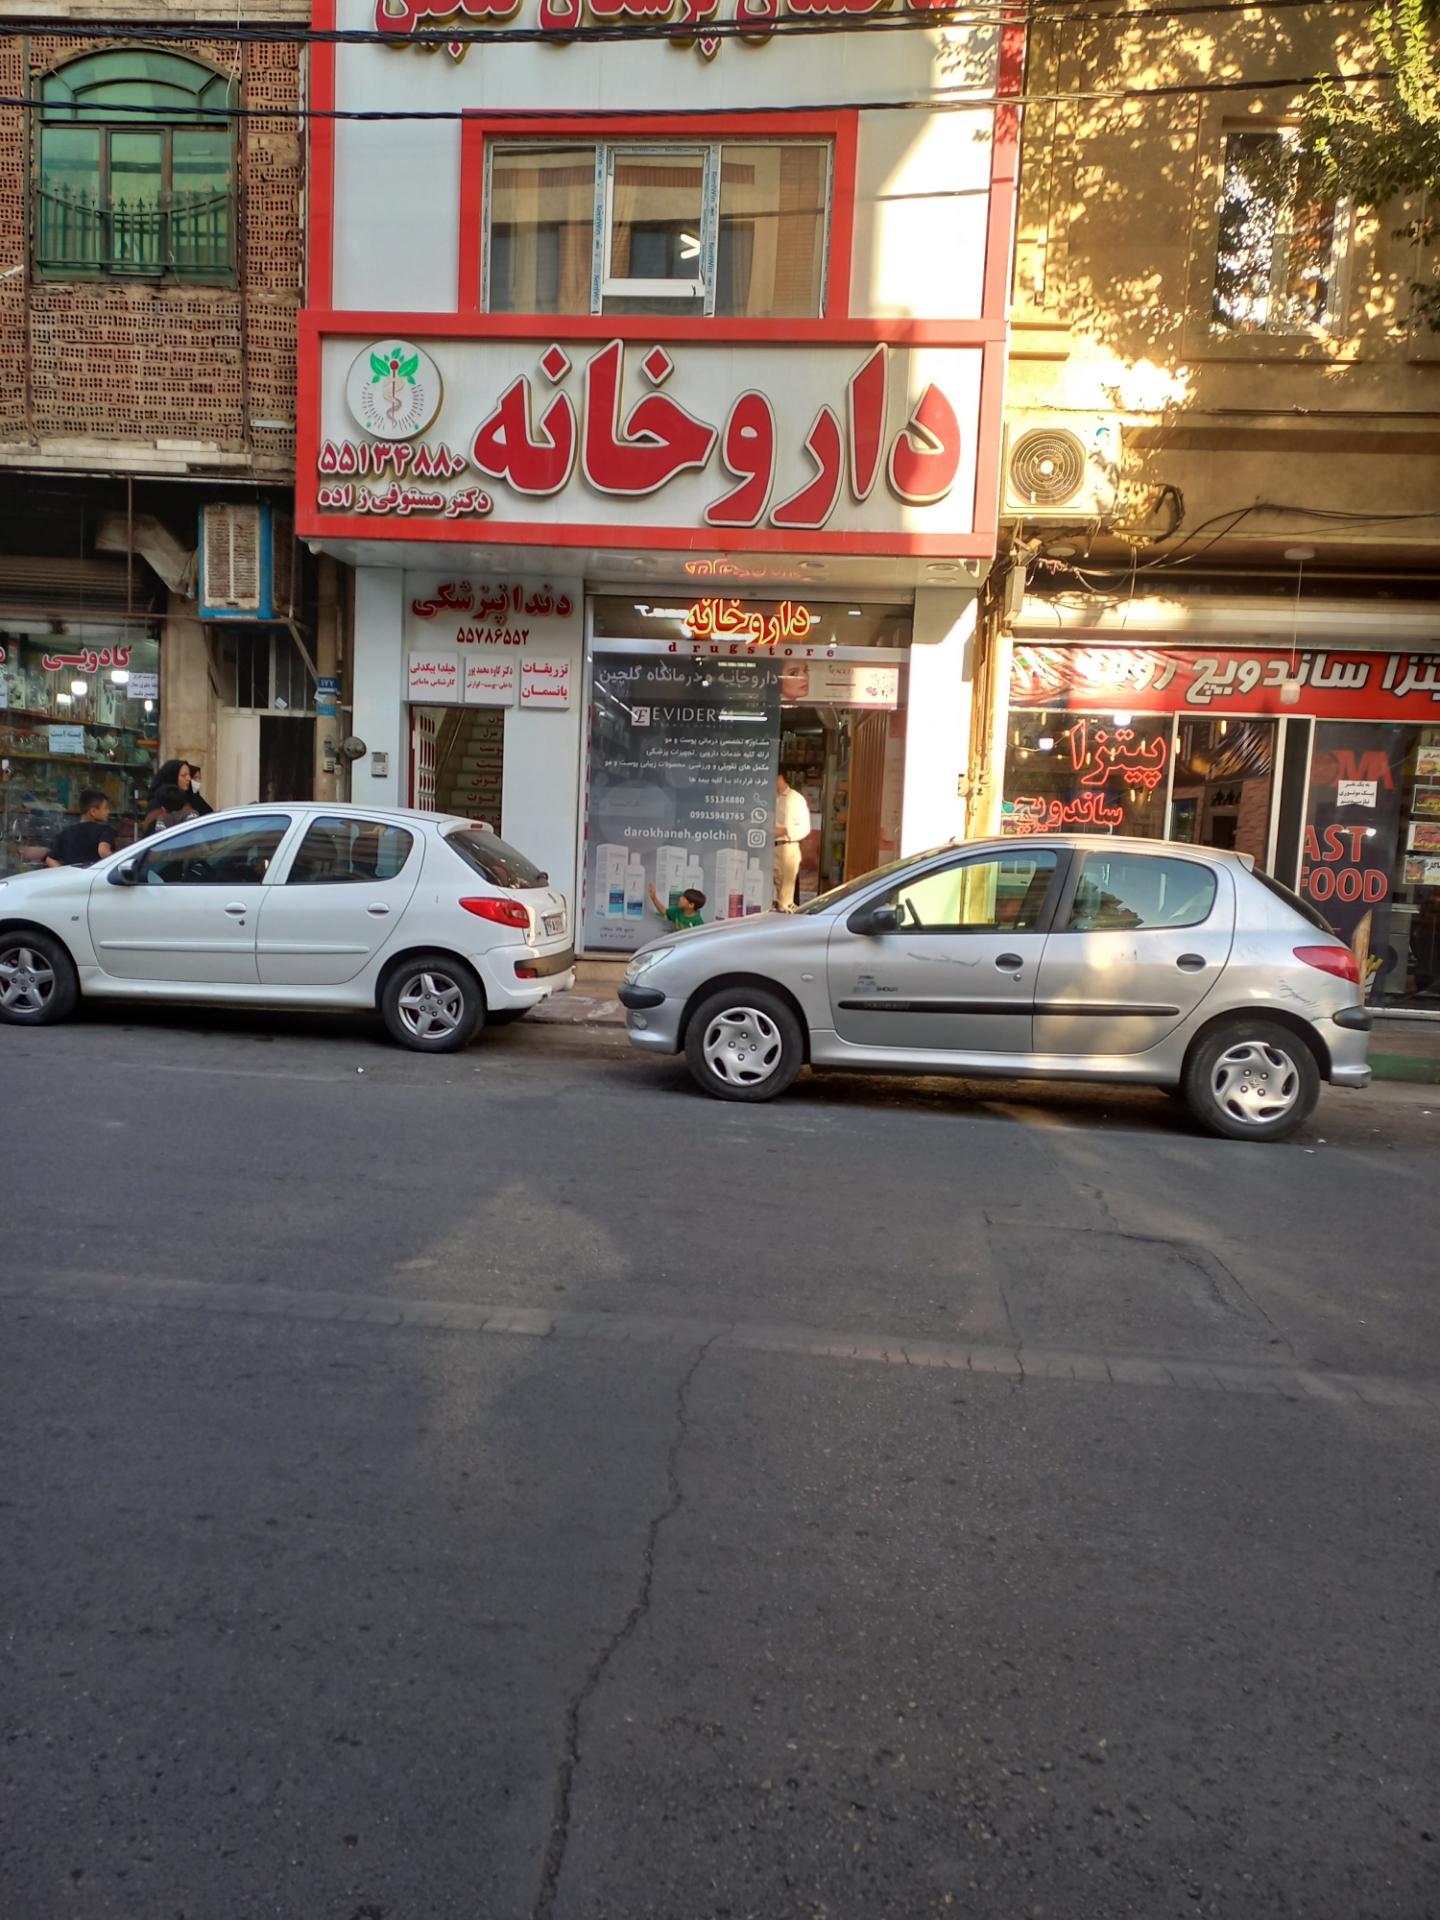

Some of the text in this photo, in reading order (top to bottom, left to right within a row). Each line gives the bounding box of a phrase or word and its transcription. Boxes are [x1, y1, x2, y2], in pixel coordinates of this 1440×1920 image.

[470, 339, 961, 529] داروخانه
[318, 440, 468, 478] ۵۵۱۳۴۸۸۰
[445, 487, 492, 517] دکتر
[411, 580, 575, 625] دندانپزشکی
[683, 598, 811, 646] داروخانه
[456, 626, 530, 646] ۵۵۷۸۶۵۵۲
[42, 645, 133, 673] کادویی
[668, 641, 835, 658] drugstore
[502, 665, 513, 678] دکتر
[522, 662, 569, 678] تزریقات
[598, 664, 643, 685] گلچین
[647, 666, 704, 687] درمانگاه
[717, 670, 778, 688] داروخانه
[1186, 651, 1370, 705] ساندویچ
[521, 683, 569, 702] پانسمان
[1069, 718, 1167, 788] پیتزا
[1008, 790, 1124, 836] ساندویچ
[623, 826, 738, 842] darokhaneh.golchin
